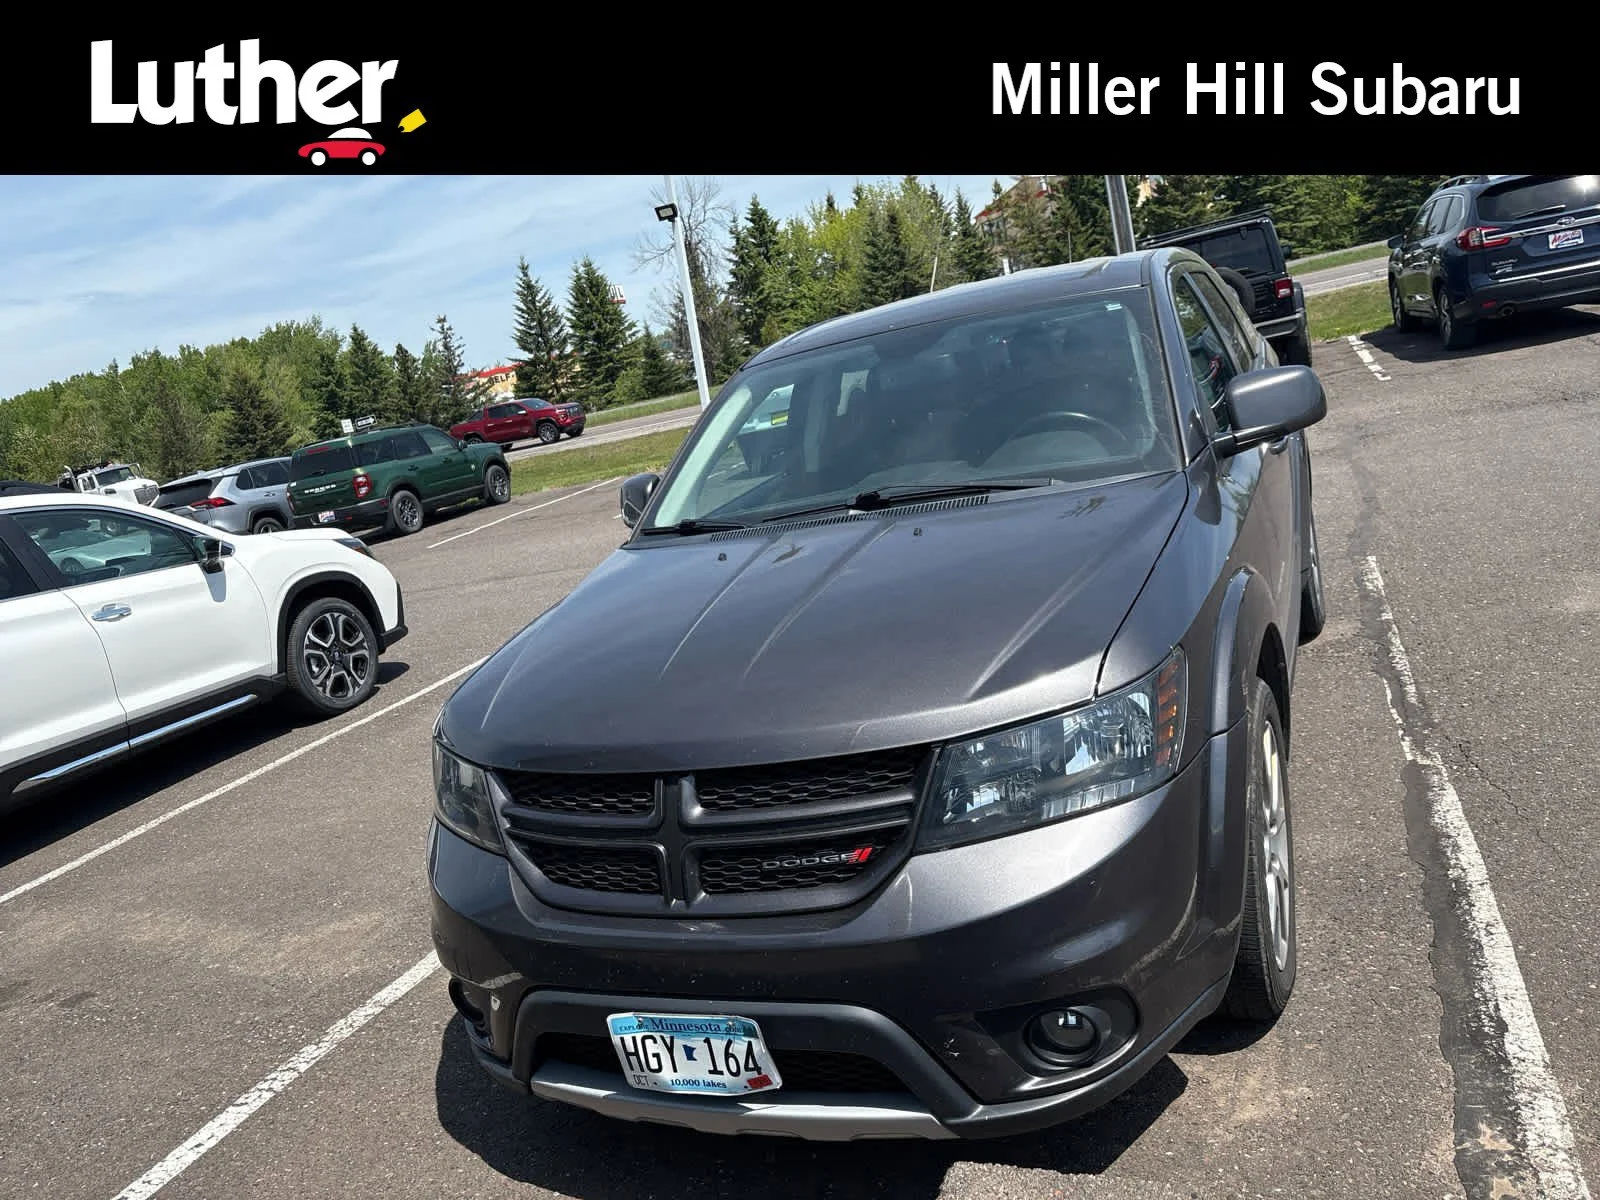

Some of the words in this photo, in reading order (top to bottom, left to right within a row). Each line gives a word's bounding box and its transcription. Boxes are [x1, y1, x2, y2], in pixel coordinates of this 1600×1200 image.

[762, 852, 858, 868] DODGE
[620, 1035, 679, 1073] HGY
[703, 1037, 762, 1077] 164
[703, 1080, 727, 1089] lakes
